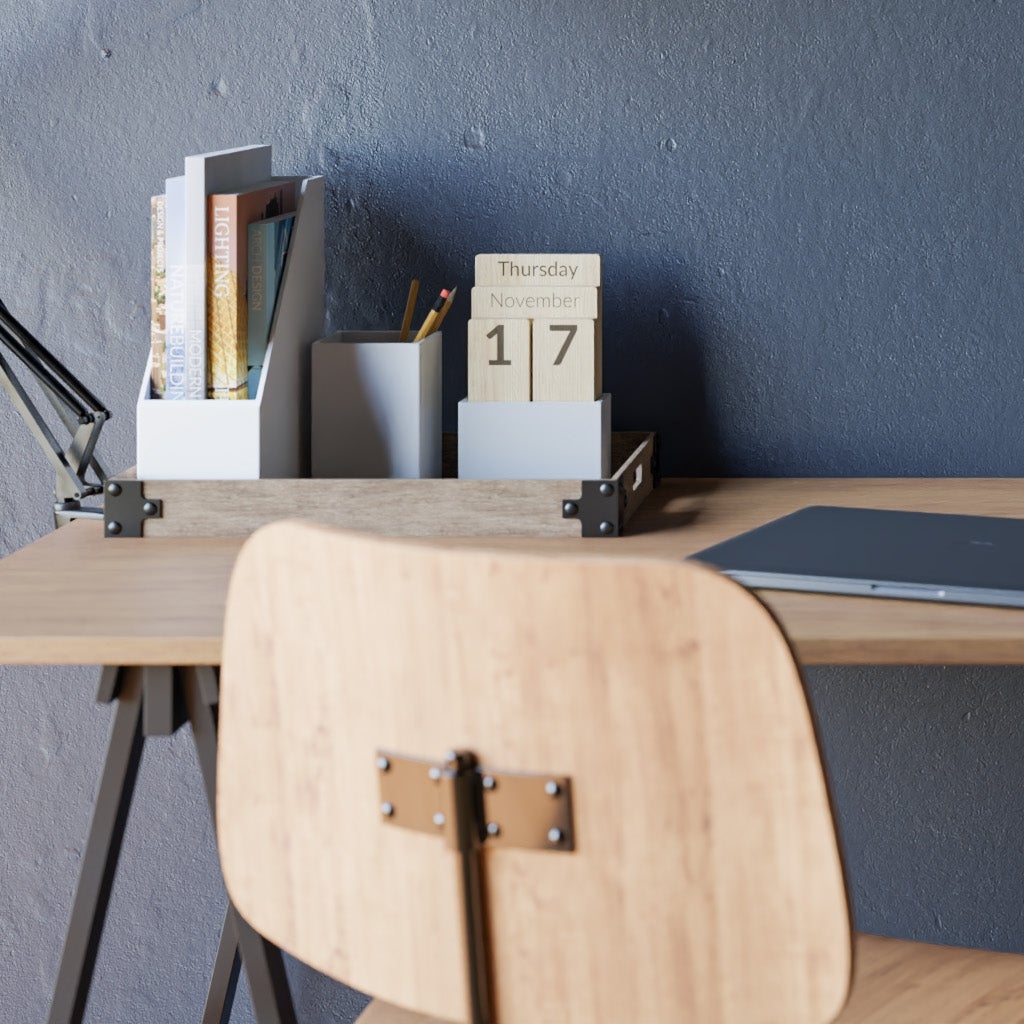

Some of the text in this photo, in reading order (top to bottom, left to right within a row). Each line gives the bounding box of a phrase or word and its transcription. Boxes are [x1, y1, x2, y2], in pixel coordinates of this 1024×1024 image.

[213, 206, 230, 298] LIGHTING
[498, 261, 579, 279] Thursday
[251, 265, 262, 311] DESIGN
[490, 292, 580, 308] November
[188, 329, 203, 398] MODERN
